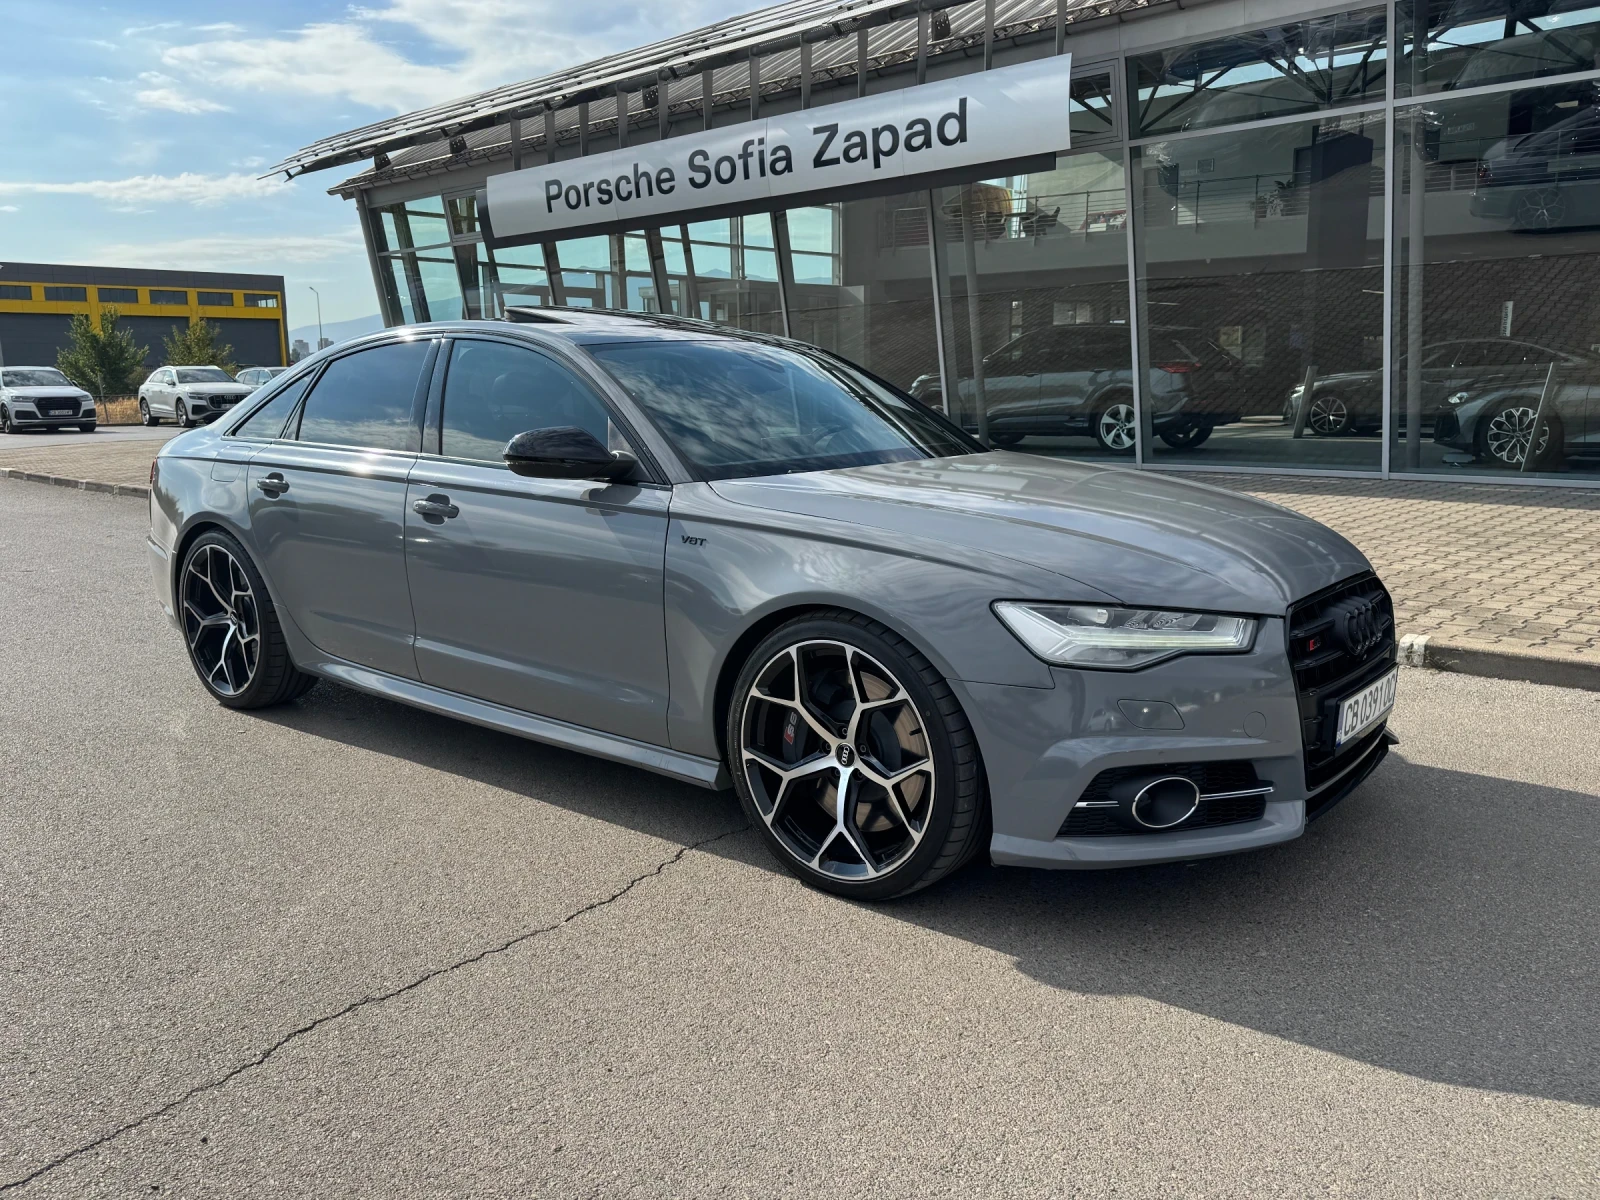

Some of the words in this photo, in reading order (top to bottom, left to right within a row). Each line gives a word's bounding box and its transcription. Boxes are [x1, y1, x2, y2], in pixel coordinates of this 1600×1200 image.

[544, 162, 676, 214] Porsche
[687, 138, 794, 190] Sofia
[812, 96, 969, 170] Zapad
[681, 535, 707, 546] V8T
[1344, 699, 1360, 737] CB
[1361, 681, 1384, 725] 0391
